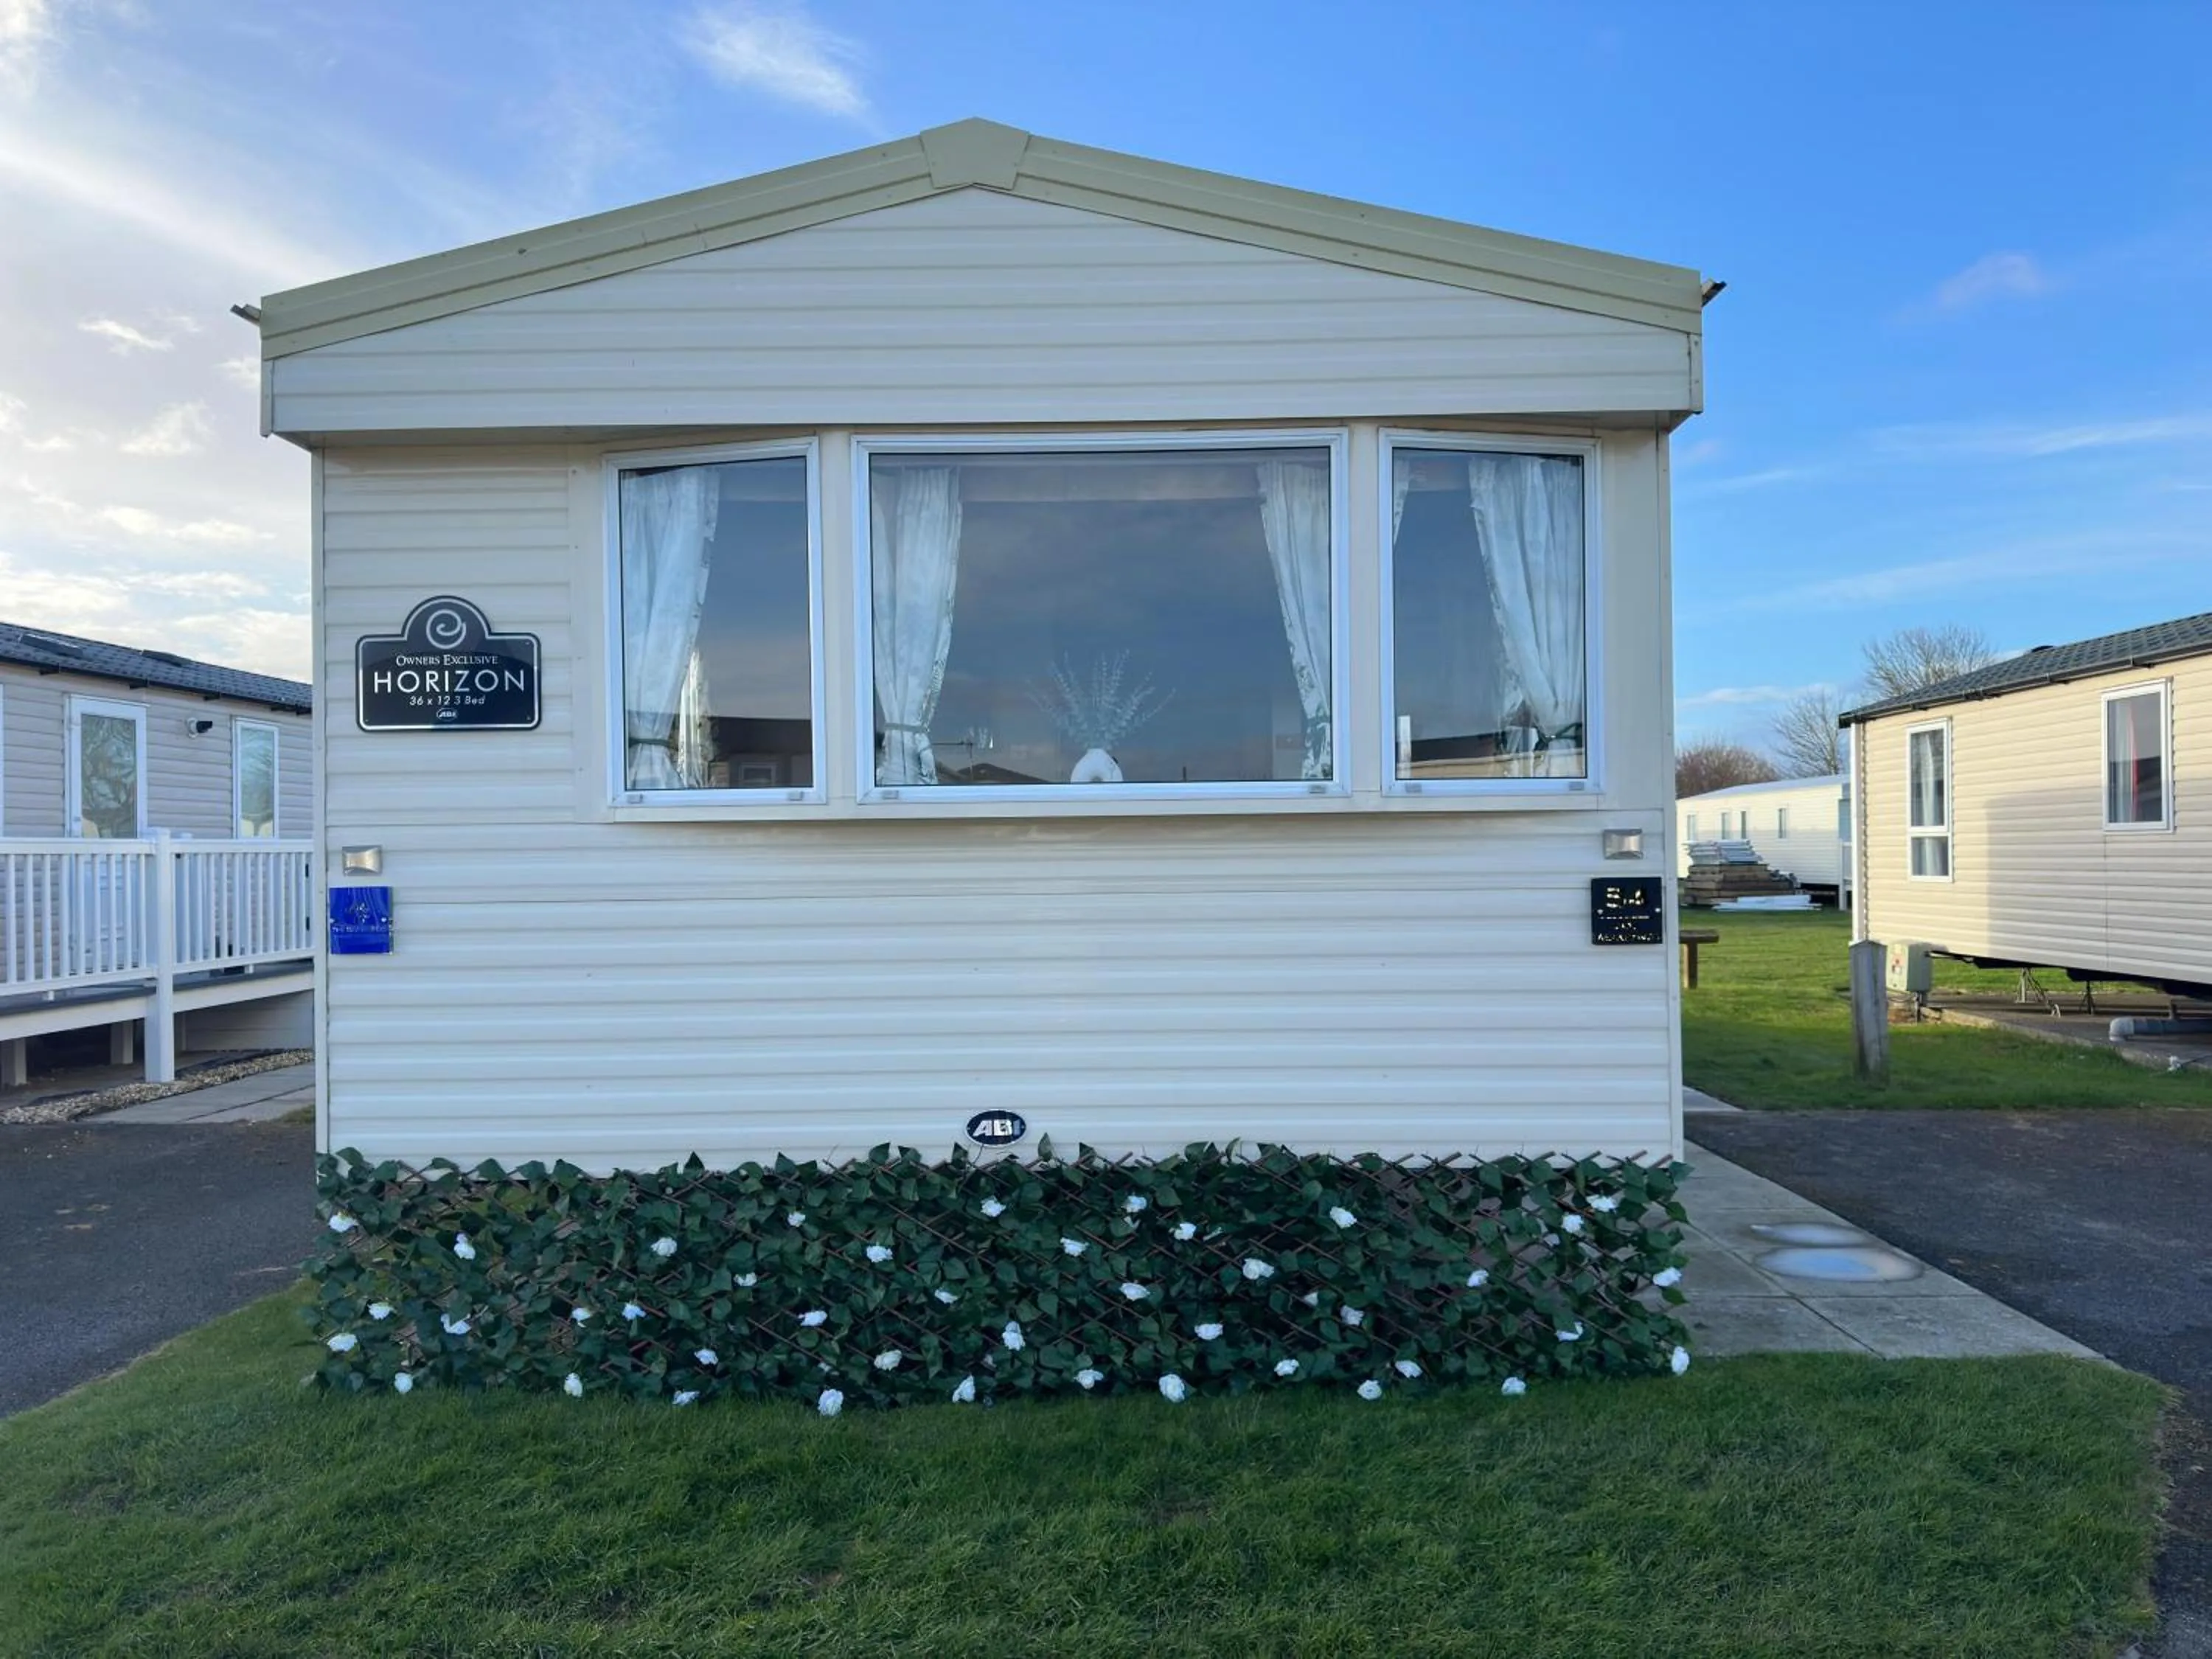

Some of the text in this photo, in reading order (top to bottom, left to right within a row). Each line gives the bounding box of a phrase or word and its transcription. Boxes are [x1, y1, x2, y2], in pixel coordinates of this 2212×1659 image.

[396, 654, 498, 666] OWNERS EXCLUSIVE
[374, 669, 524, 693] HORIZON
[409, 695, 424, 706] 36
[437, 695, 451, 706] 12
[453, 695, 461, 706] 3
[465, 695, 485, 705] Bed
[973, 1119, 1021, 1137] ABI
